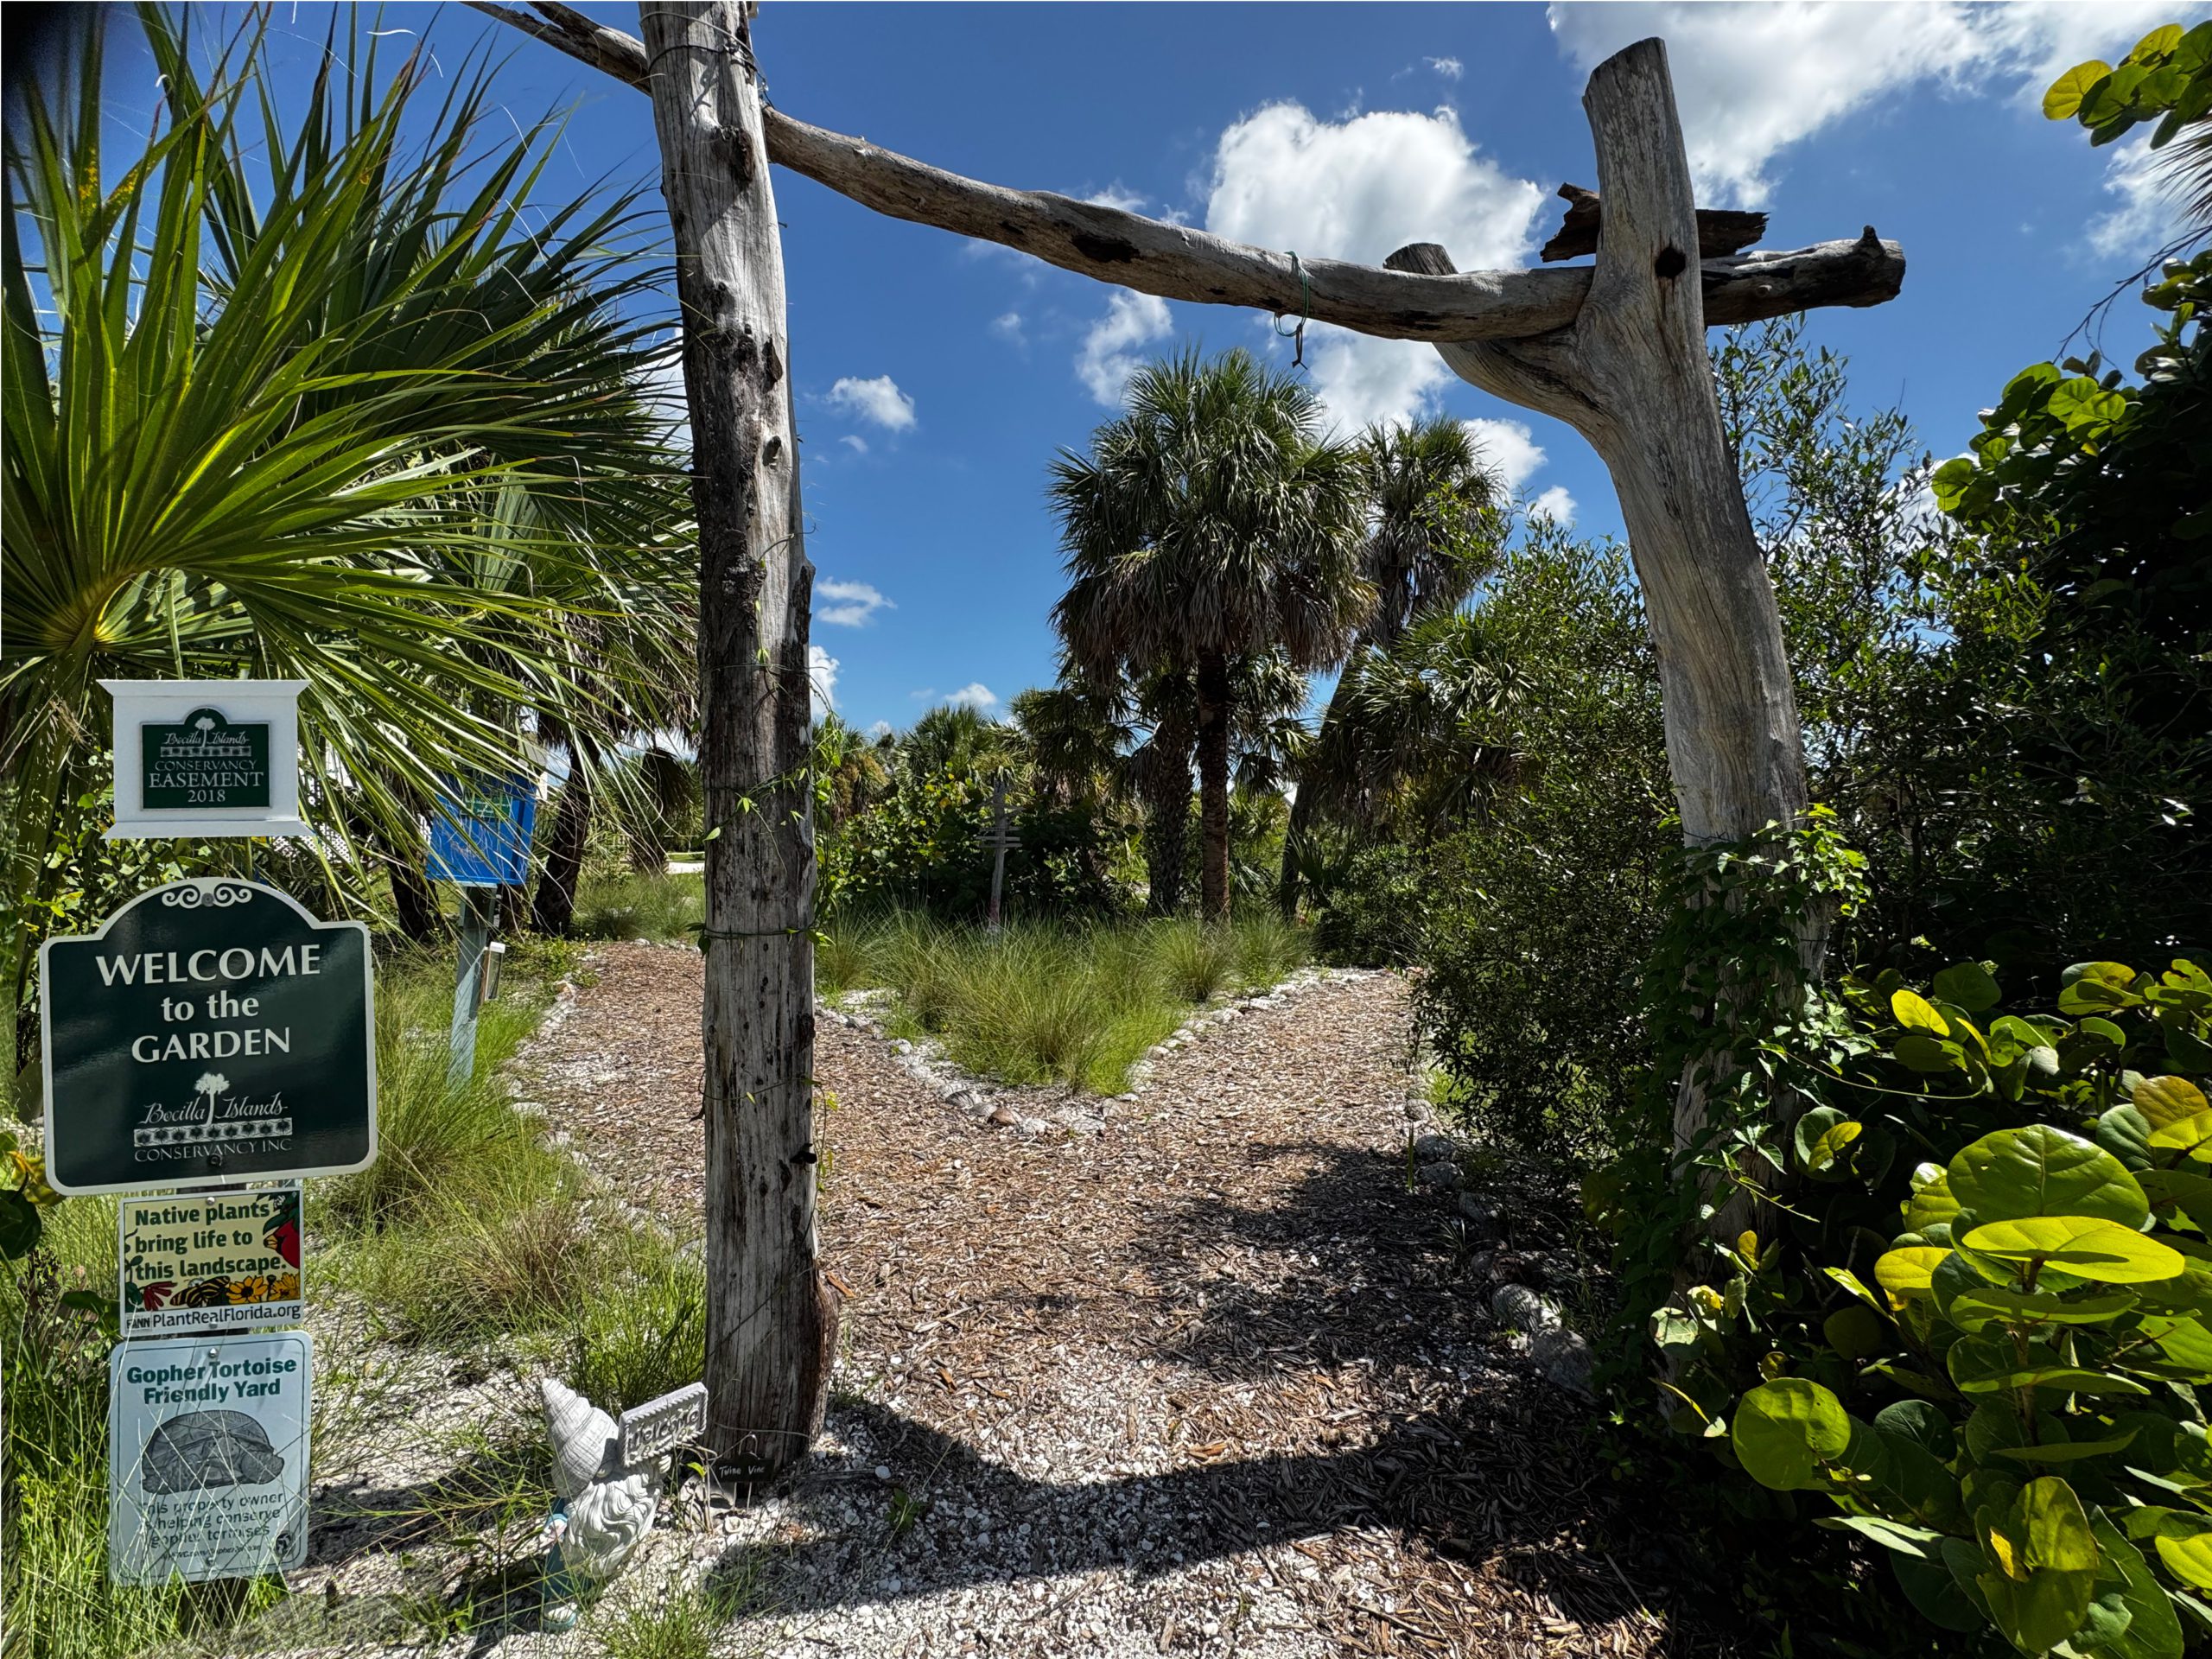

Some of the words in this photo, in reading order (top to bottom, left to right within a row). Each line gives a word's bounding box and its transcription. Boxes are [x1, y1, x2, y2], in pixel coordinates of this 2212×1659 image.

[207, 730, 250, 744] Islands
[155, 760, 257, 771] CONSERVANCY
[149, 772, 264, 788] EASEMENT
[188, 789, 226, 802] 2018
[96, 944, 321, 987] WELCOME
[161, 996, 194, 1022] to
[207, 990, 258, 1019] the
[131, 1027, 290, 1064] GARDEN
[138, 1096, 205, 1124] Bocilla
[215, 1091, 288, 1119] Islands
[135, 1141, 257, 1162] CONSERVANCY
[262, 1138, 292, 1153] INC
[136, 1205, 200, 1226] Native
[206, 1202, 270, 1225] plants
[136, 1236, 188, 1255] bring
[194, 1230, 226, 1249] life
[232, 1230, 252, 1246] to
[136, 1261, 173, 1281] this
[180, 1256, 287, 1277] landscape.
[153, 1304, 302, 1327] PlantRealFlorida.org
[127, 1364, 206, 1385] Gopher
[209, 1357, 297, 1378] Tortoise
[143, 1382, 230, 1404] Friendly
[234, 1378, 280, 1398] Yard
